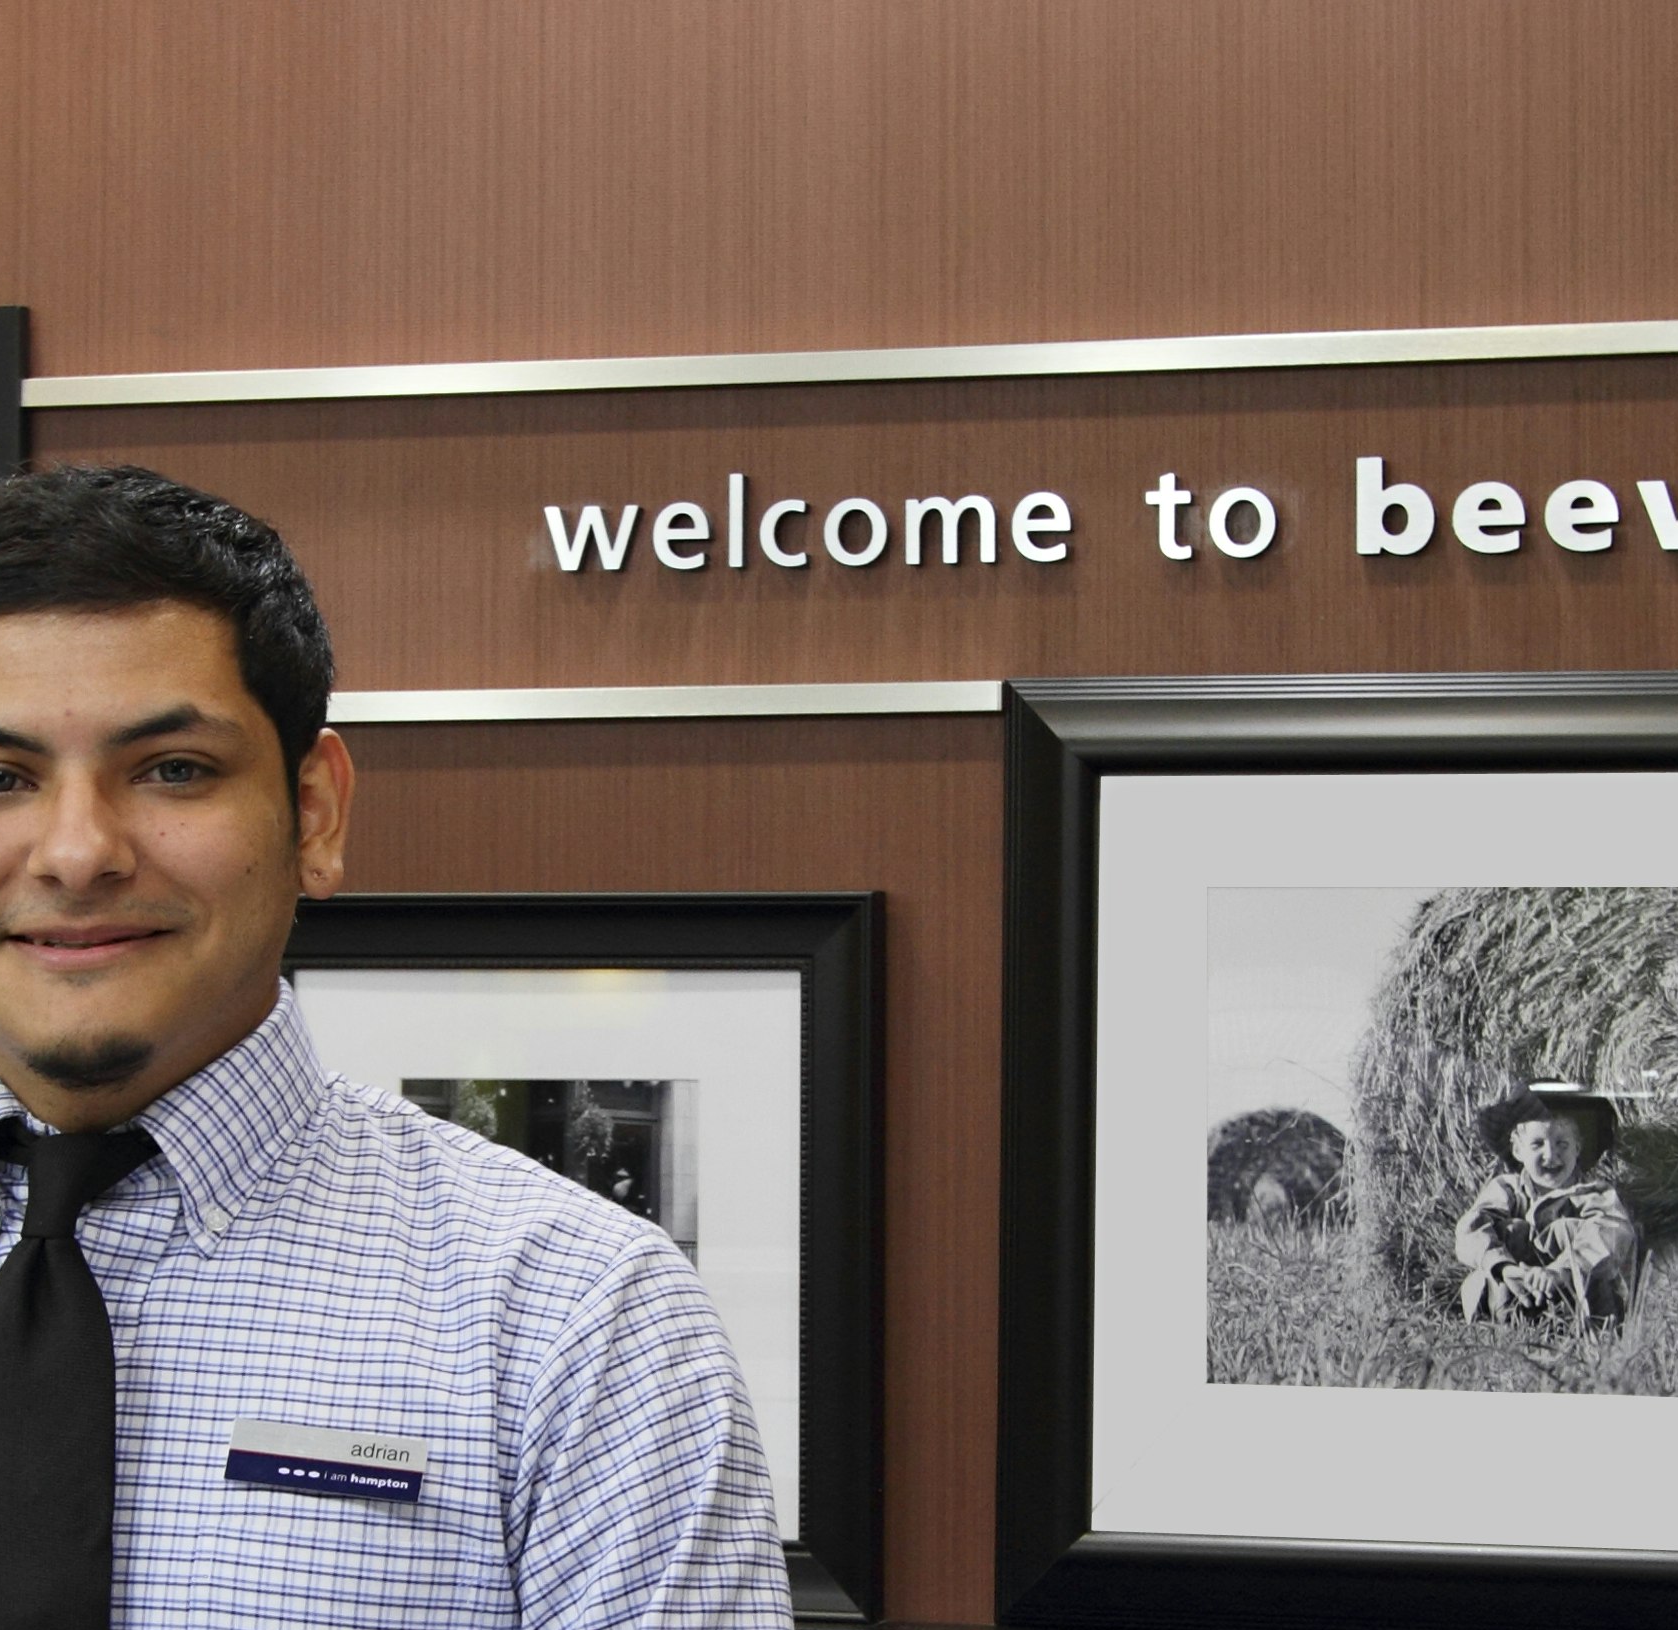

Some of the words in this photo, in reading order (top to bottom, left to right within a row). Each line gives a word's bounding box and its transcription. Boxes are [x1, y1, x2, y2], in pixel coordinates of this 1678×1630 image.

[544, 473, 1073, 572] welcome
[1145, 471, 1278, 562] to
[350, 1443, 410, 1463] adrian
[330, 1473, 348, 1483] am
[350, 1473, 409, 1491] hampton
